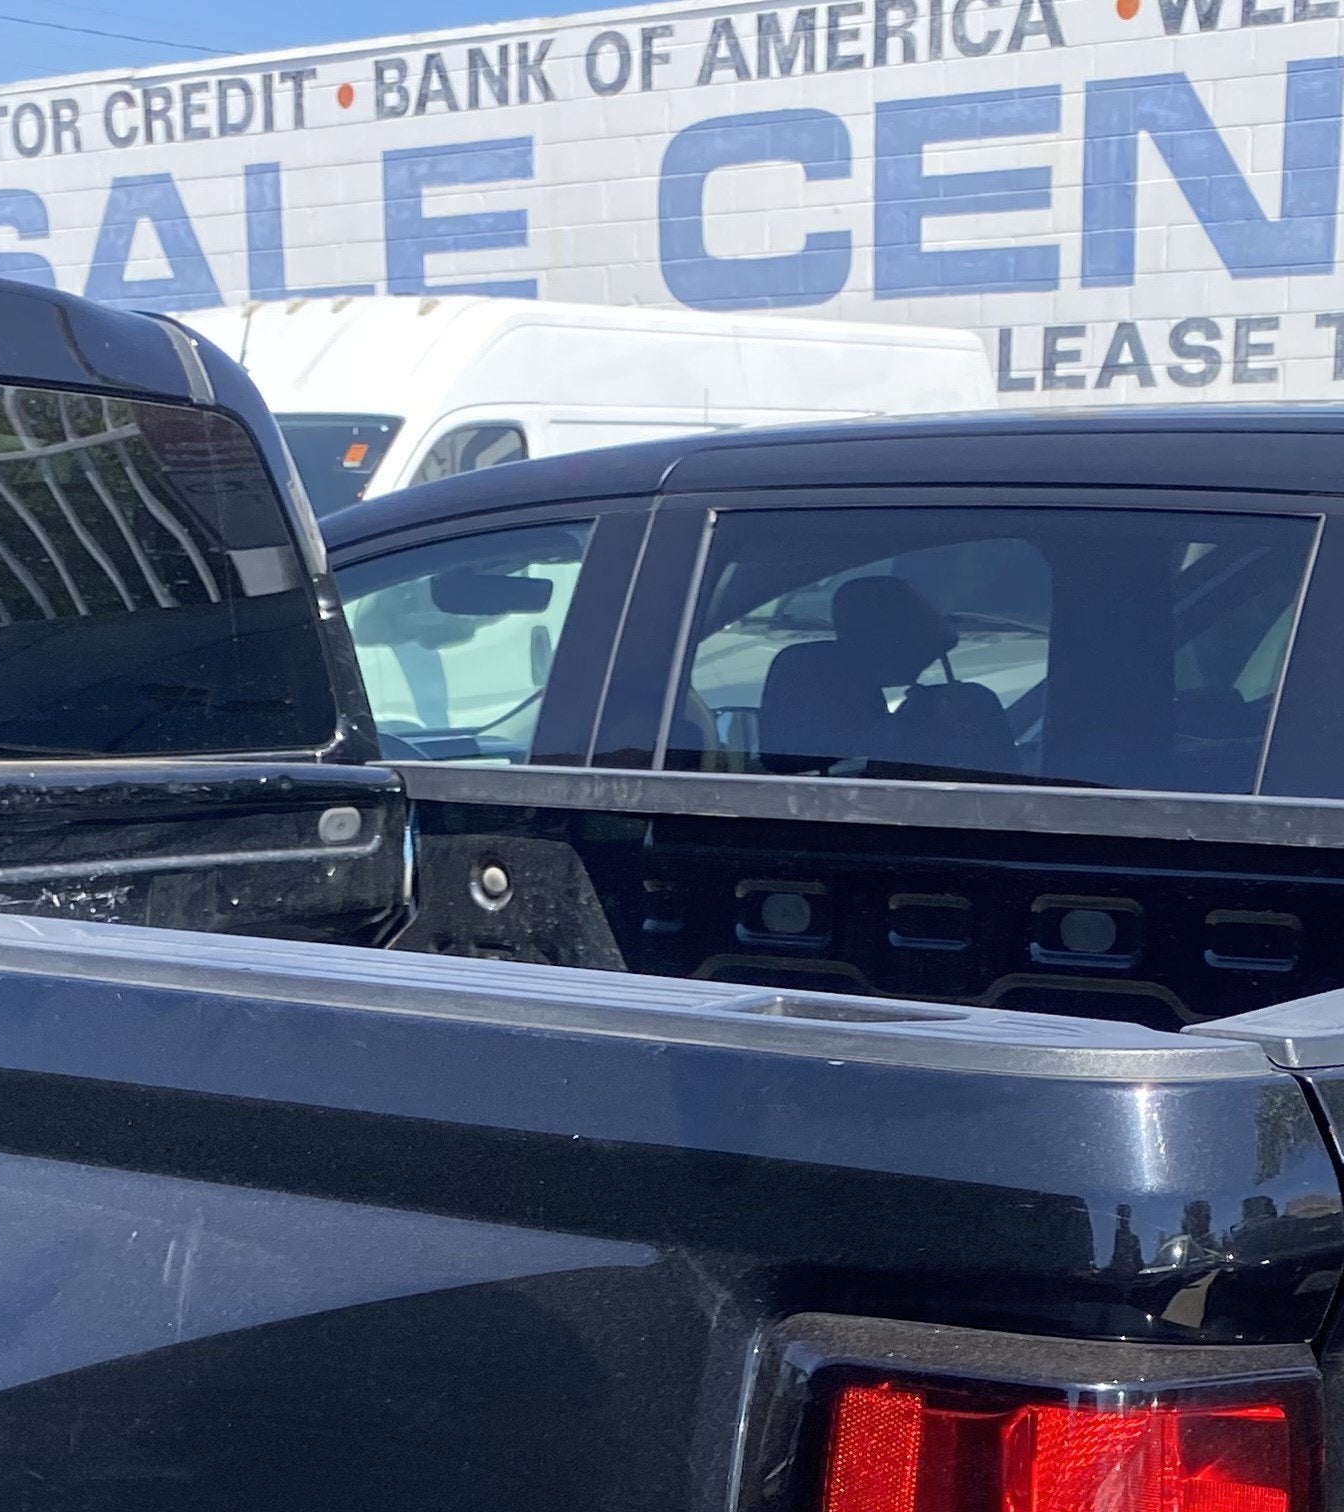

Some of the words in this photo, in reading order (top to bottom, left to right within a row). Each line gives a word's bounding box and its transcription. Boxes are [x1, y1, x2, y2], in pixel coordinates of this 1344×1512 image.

[104, 67, 317, 150] CREDIT
[373, 38, 556, 120] BANK
[584, 25, 674, 97] OF
[696, 0, 1066, 87] AMERICA
[997, 315, 1281, 393] LEASE
